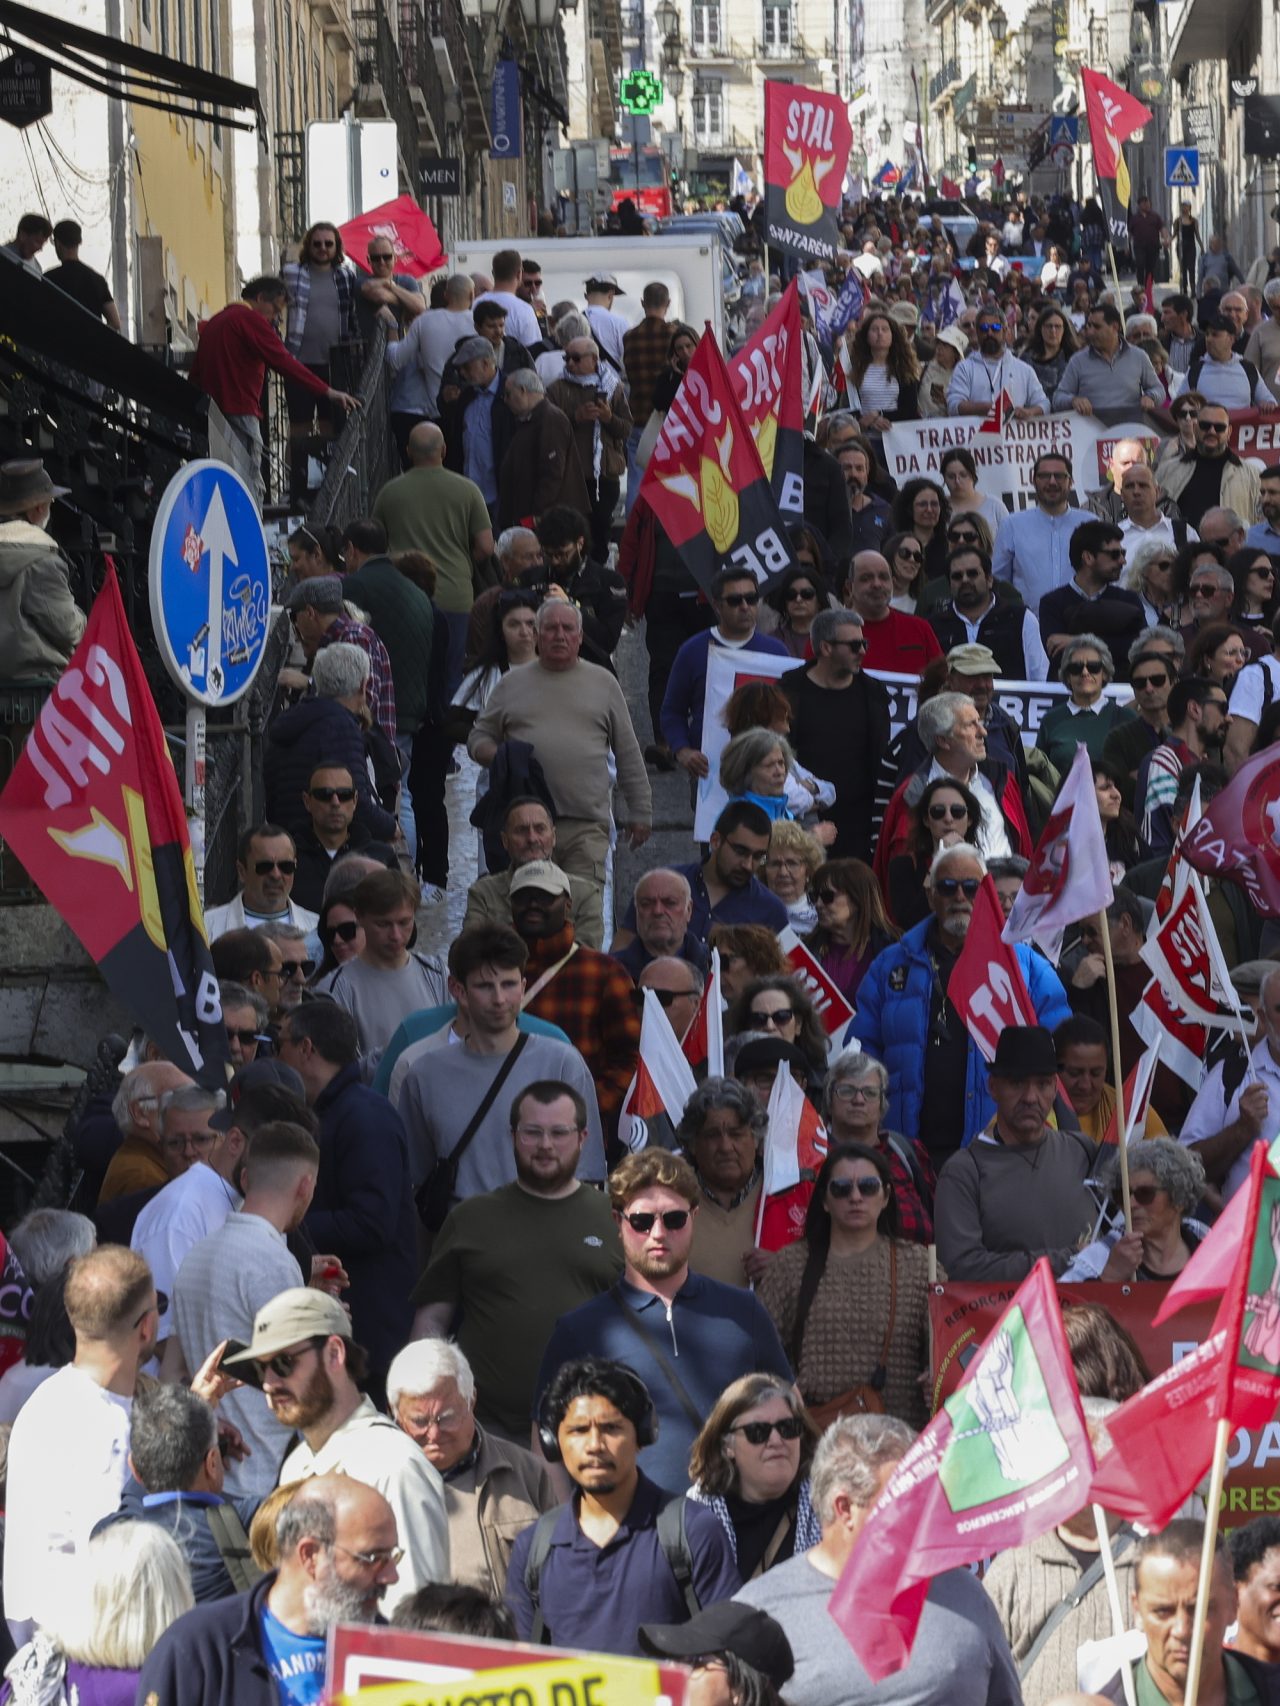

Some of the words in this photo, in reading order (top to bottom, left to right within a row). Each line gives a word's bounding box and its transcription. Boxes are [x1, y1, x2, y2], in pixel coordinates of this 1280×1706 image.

[786, 99, 834, 152] STAL
[769, 223, 834, 259] SANTARÉM
[916, 419, 1073, 450] TRABAADORES
[896, 452, 921, 475] DA
